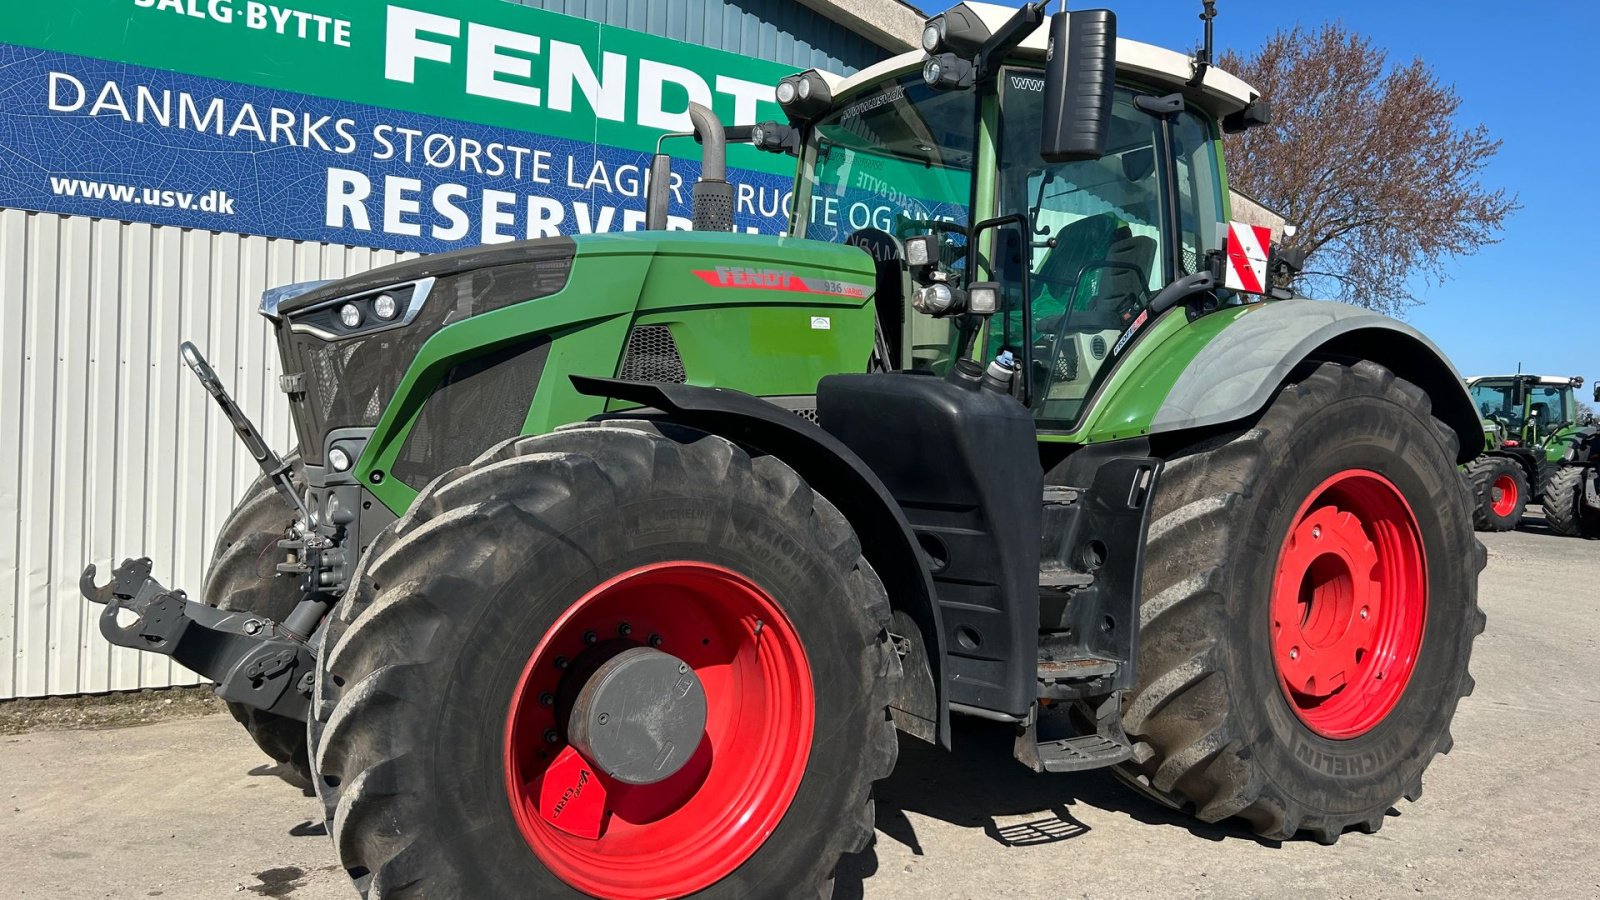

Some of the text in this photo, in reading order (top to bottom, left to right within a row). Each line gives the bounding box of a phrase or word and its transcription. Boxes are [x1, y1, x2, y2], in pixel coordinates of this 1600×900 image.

[134, 0, 351, 47] ALG·BYTTE
[385, 5, 779, 146] FENDT
[49, 71, 357, 153] DANMARKS
[373, 125, 551, 184] STØRSTE
[849, 202, 891, 234] OG
[50, 176, 235, 215] www.usv.dk
[714, 266, 863, 296] FENDT 936 VARIO
[1296, 735, 1402, 778] MICHELIN
